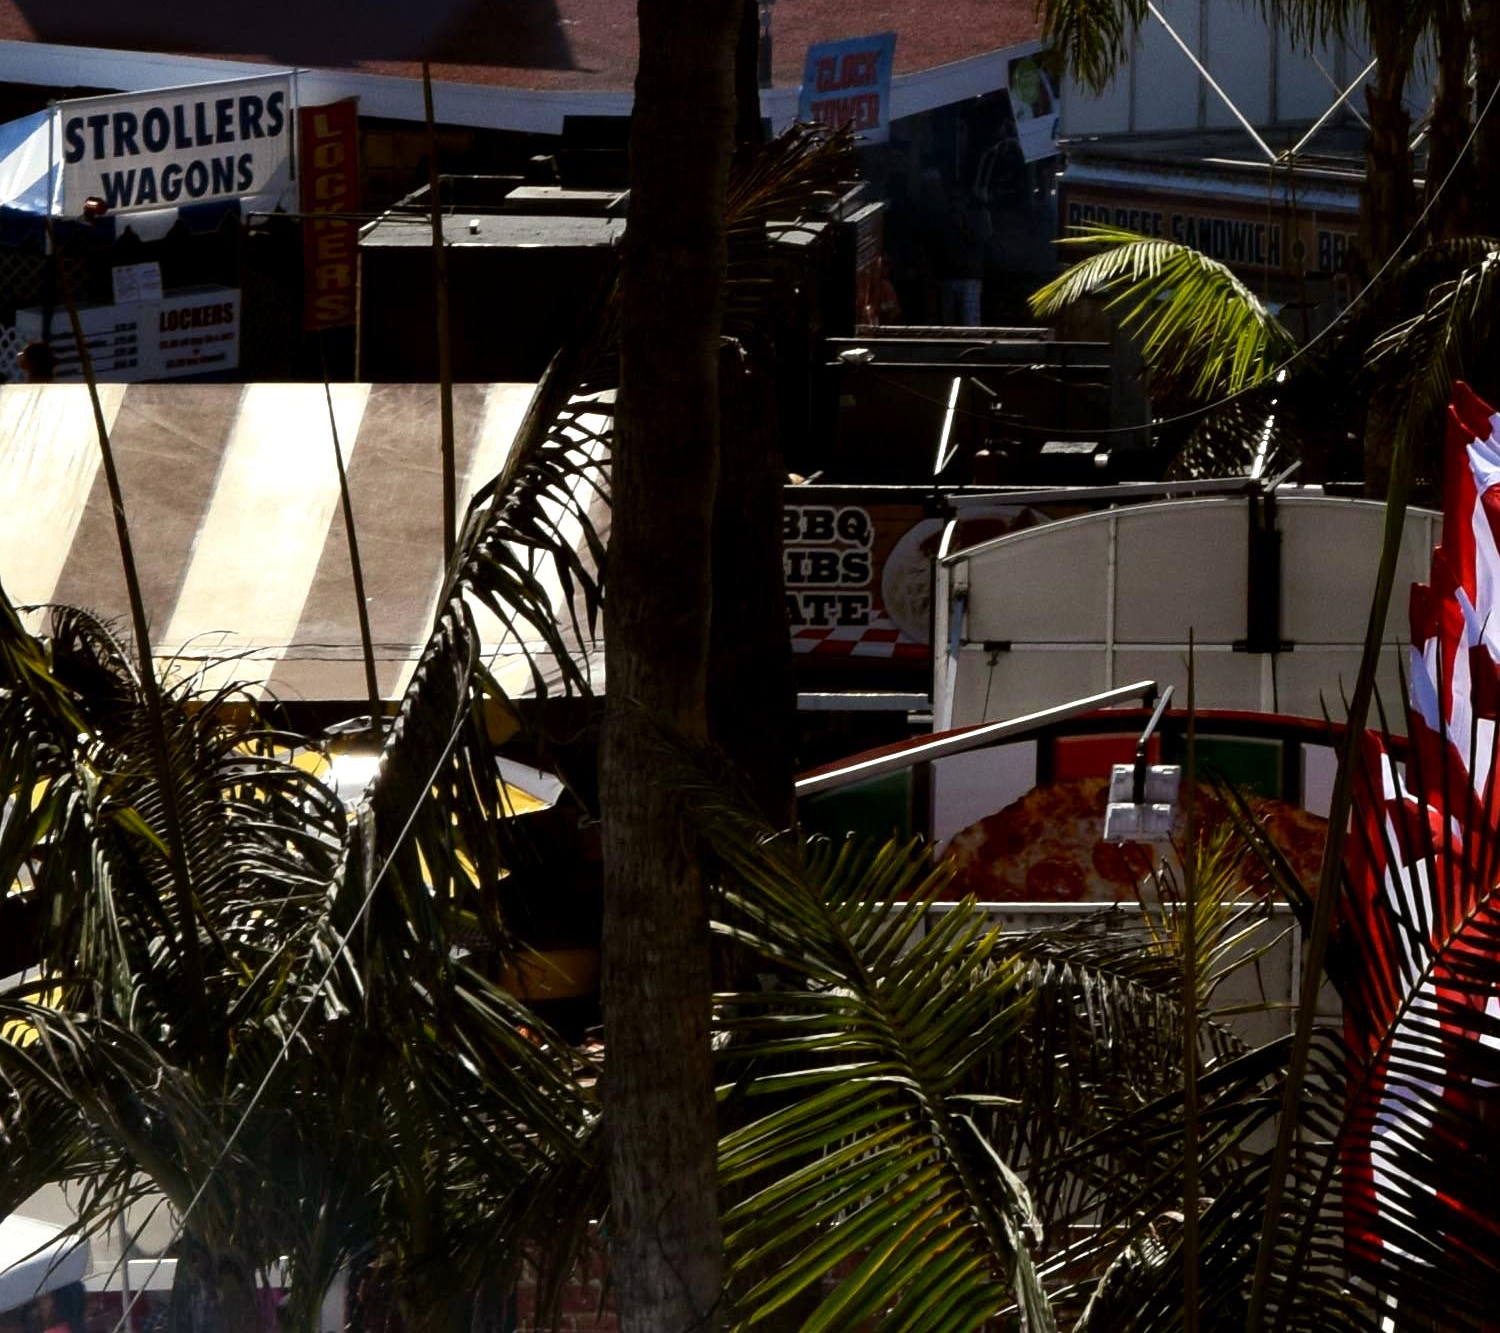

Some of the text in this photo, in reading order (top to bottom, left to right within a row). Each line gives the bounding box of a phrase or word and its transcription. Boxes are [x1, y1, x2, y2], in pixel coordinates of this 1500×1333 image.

[64, 91, 285, 165] STROLLERS
[101, 152, 253, 209] WAGONS
[313, 112, 351, 323] LOCKERS
[1170, 212, 1281, 268] SANDWICH
[159, 302, 234, 333] LOCKERS
[784, 549, 873, 587] IBS
